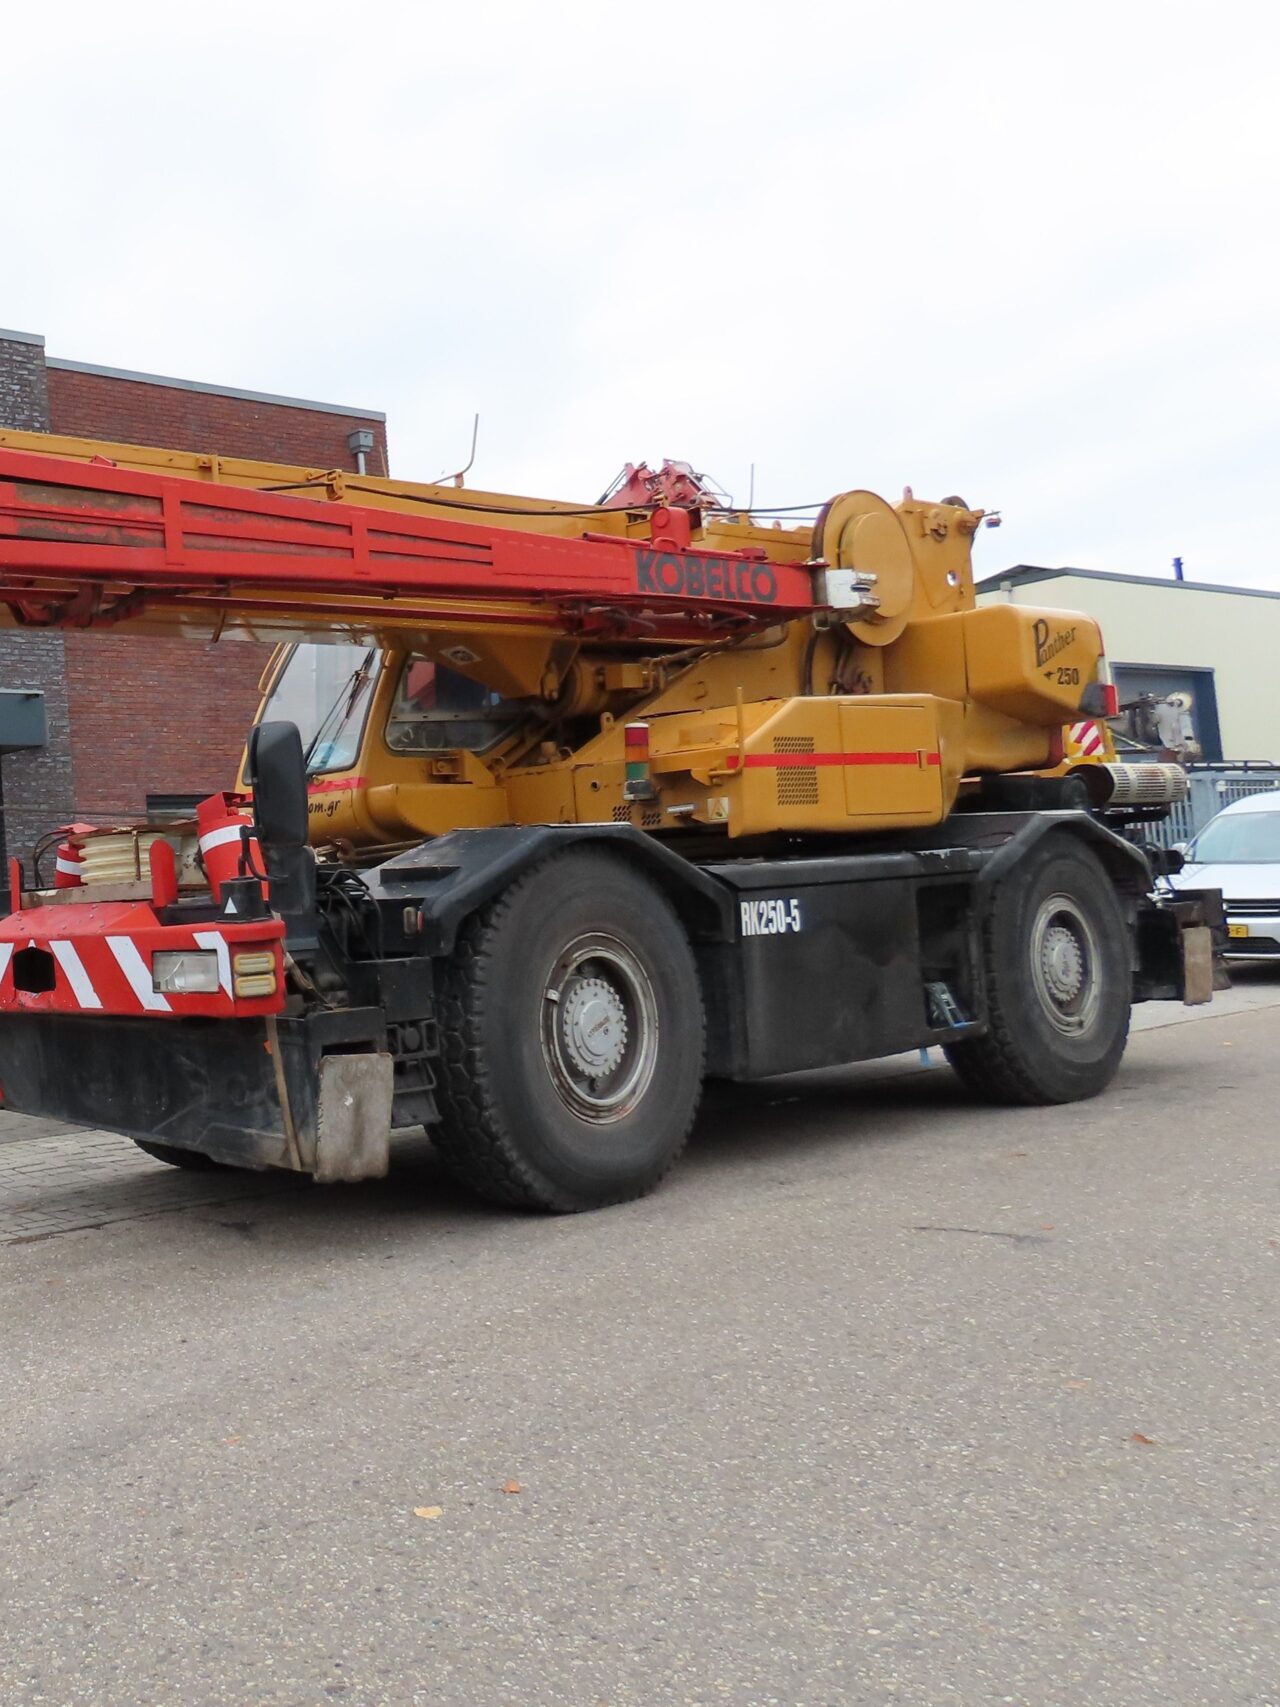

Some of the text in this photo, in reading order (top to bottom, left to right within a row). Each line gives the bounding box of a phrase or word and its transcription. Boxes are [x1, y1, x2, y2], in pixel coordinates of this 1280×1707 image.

[635, 548, 777, 602] KOBELCO
[1032, 618, 1076, 667] Panther
[1056, 667, 1079, 685] 250
[740, 898, 800, 936] RK250-5
